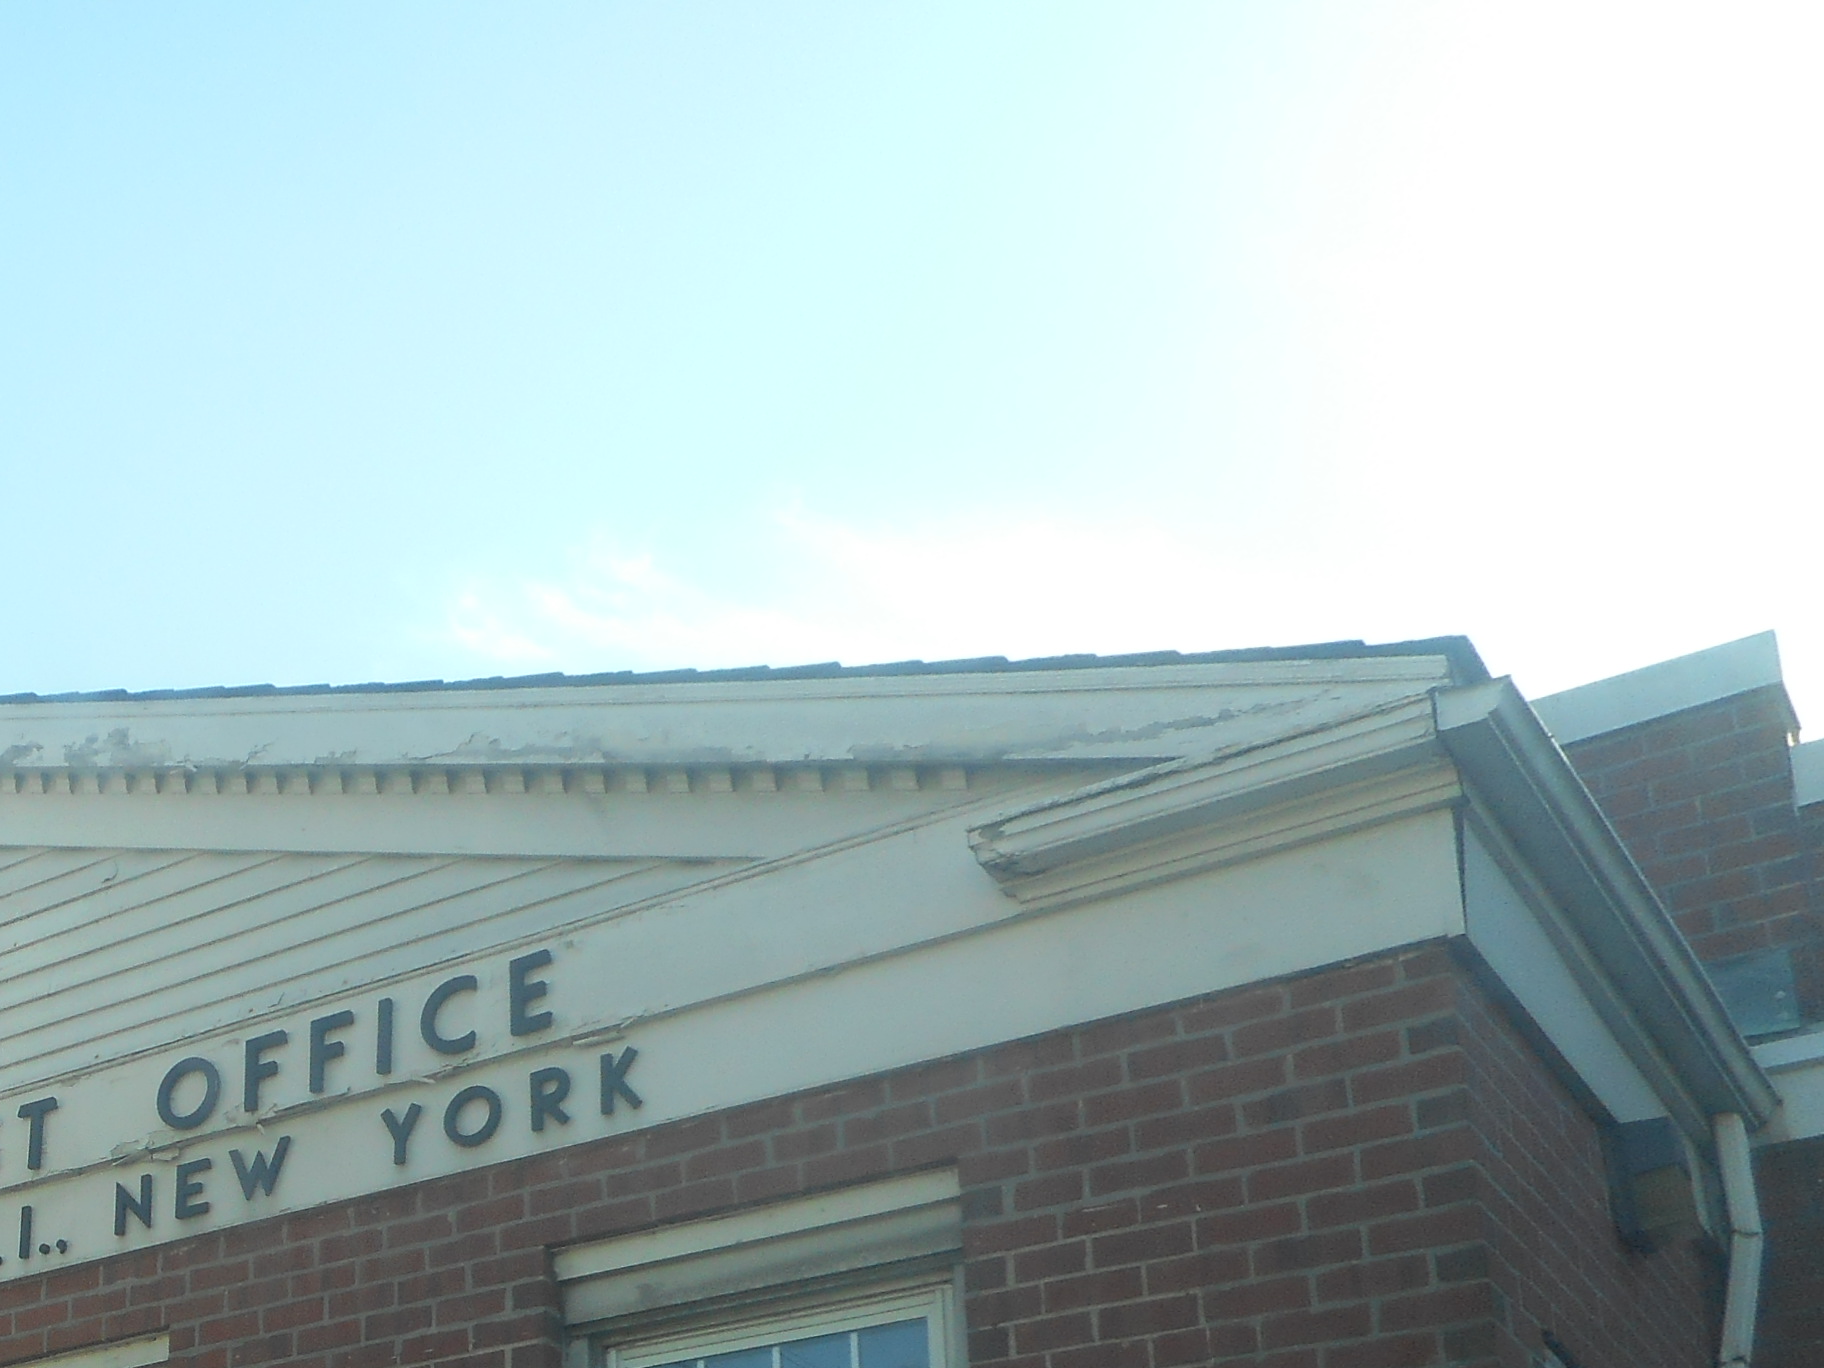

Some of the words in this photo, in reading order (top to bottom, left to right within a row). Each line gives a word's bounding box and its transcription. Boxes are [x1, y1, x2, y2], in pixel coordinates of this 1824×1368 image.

[156, 948, 554, 1133] OFFICE
[113, 1135, 292, 1238] NEW
[380, 1046, 643, 1167] YORK
